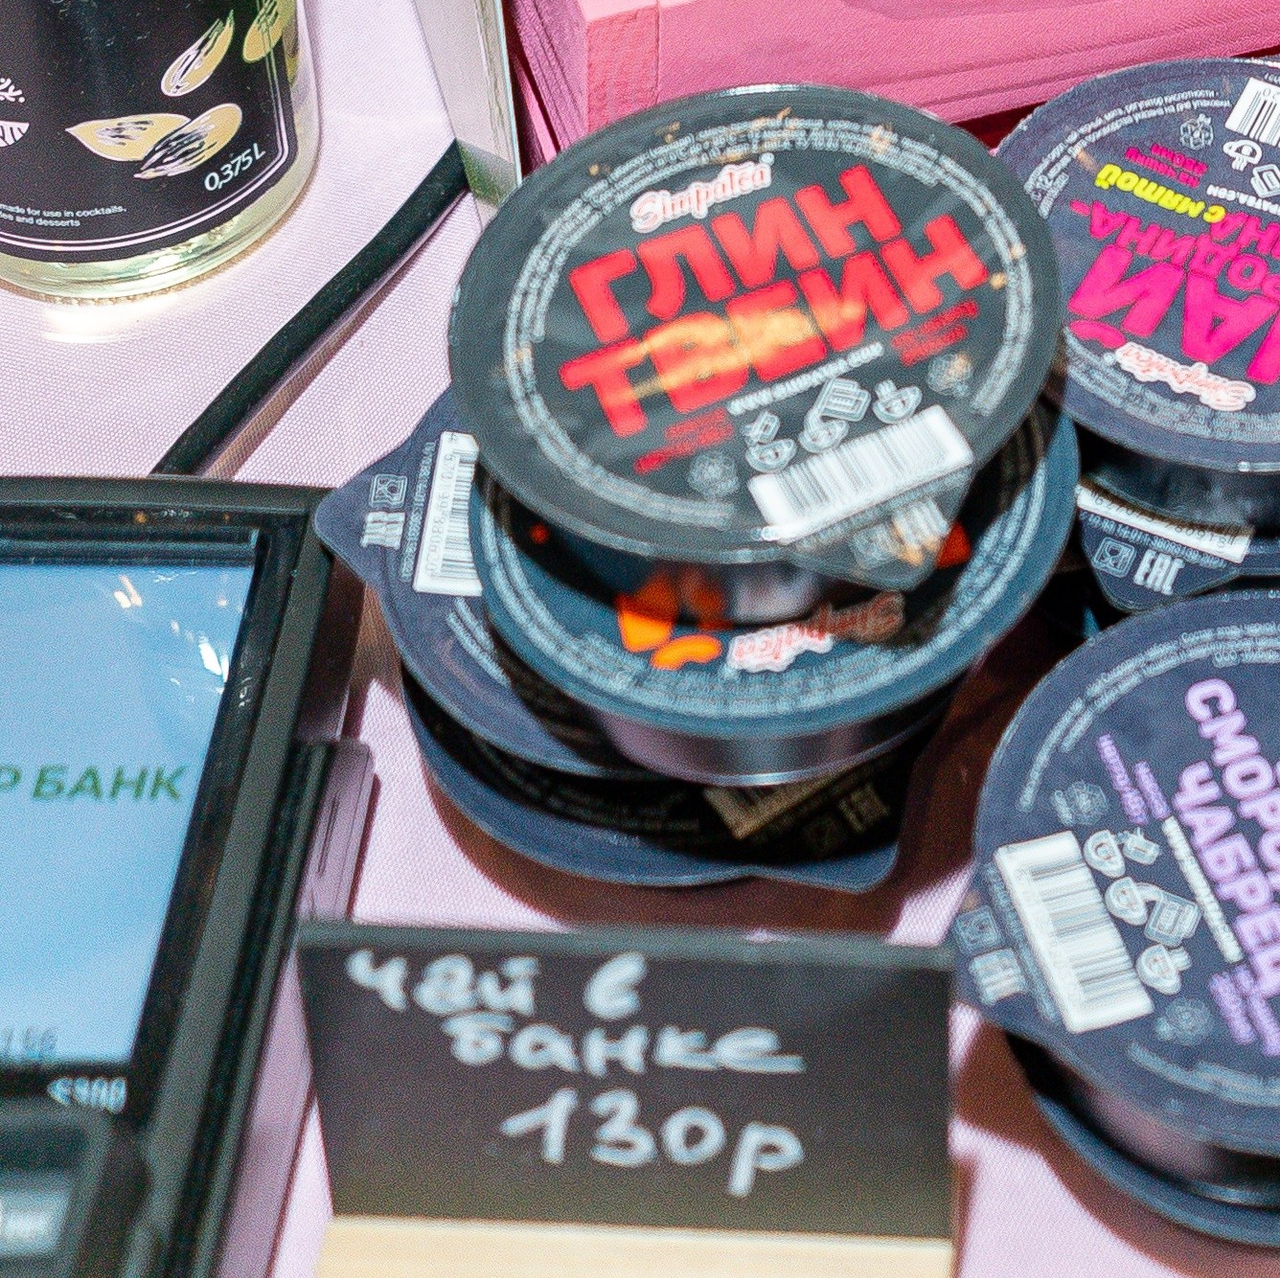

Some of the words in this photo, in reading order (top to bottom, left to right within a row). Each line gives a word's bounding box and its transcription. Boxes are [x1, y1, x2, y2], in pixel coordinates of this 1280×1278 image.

[27, 205, 41, 216] for
[63, 209, 74, 218] in
[35, 218, 80, 227] desserts
[630, 160, 776, 234] Simpatea
[568, 164, 901, 344] ГЛИН
[1113, 342, 1257, 412] Simpatea
[32, 762, 187, 804] БАНК
[347, 945, 542, 1018] чай
[441, 1011, 804, 1076] банке
[500, 1086, 804, 1198] 130р
